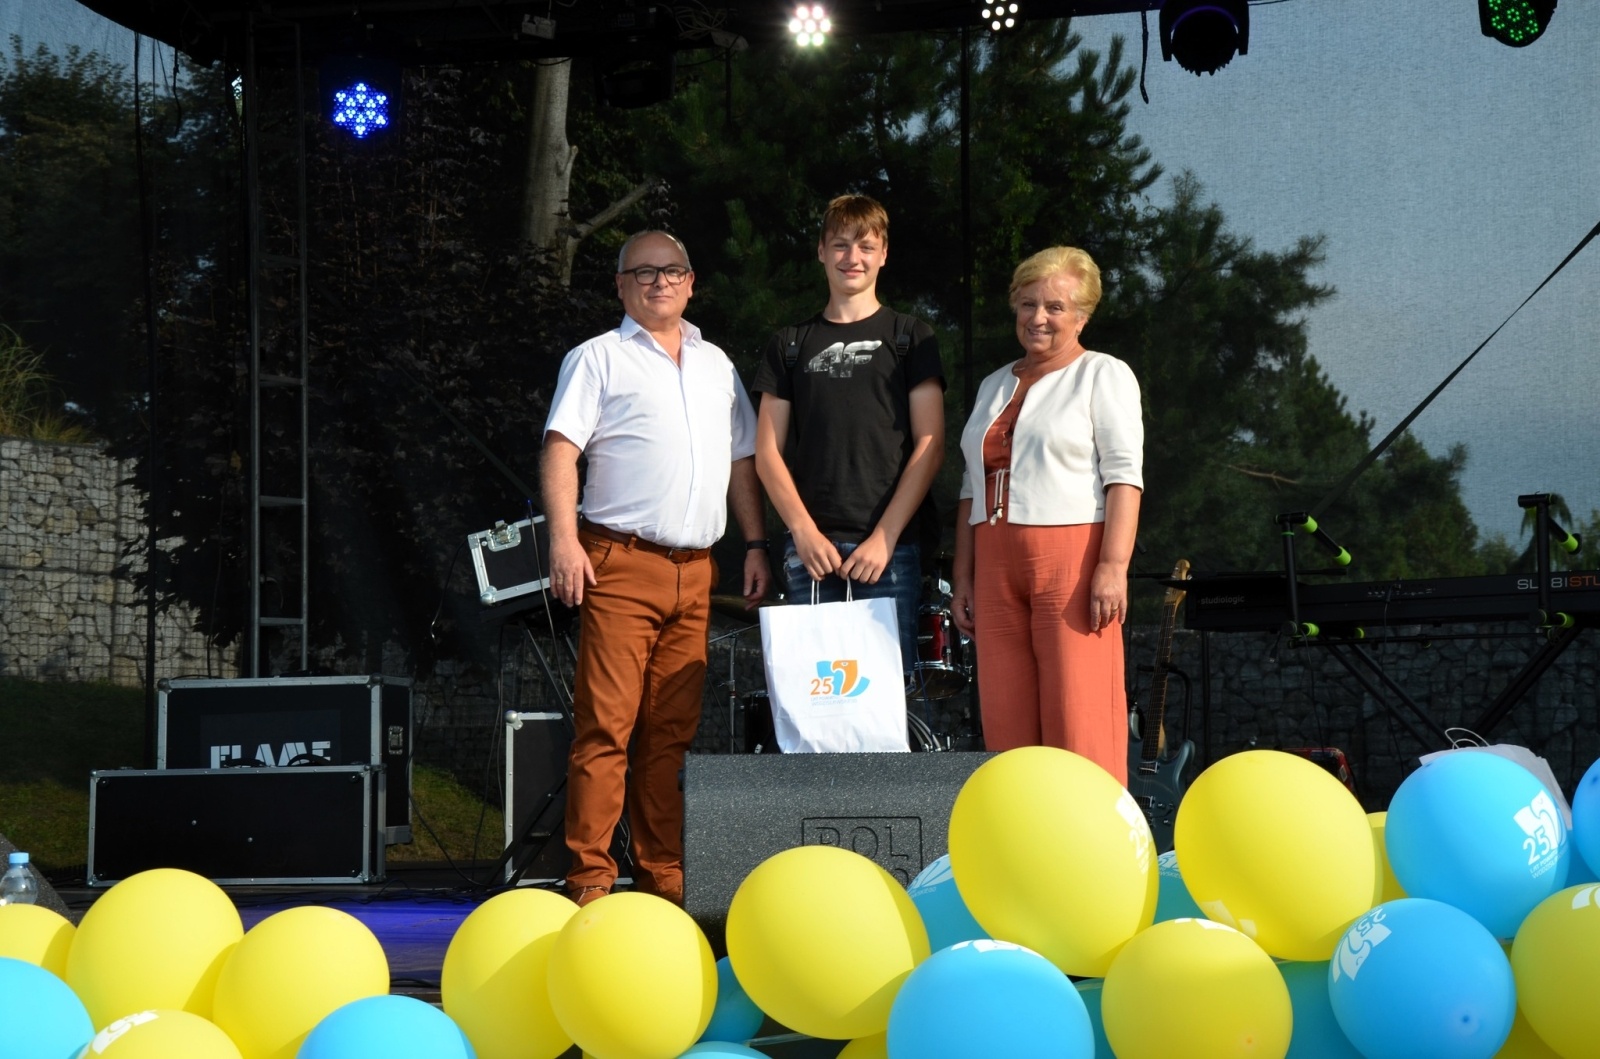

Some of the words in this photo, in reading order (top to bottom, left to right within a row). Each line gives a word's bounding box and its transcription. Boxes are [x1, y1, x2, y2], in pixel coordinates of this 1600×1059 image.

[804, 340, 882, 378] 4F
[1200, 595, 1245, 605] studiologic
[810, 678, 832, 695] 25
[815, 826, 909, 861] POL
[1523, 826, 1551, 866] 25
[1357, 908, 1387, 937] 25
